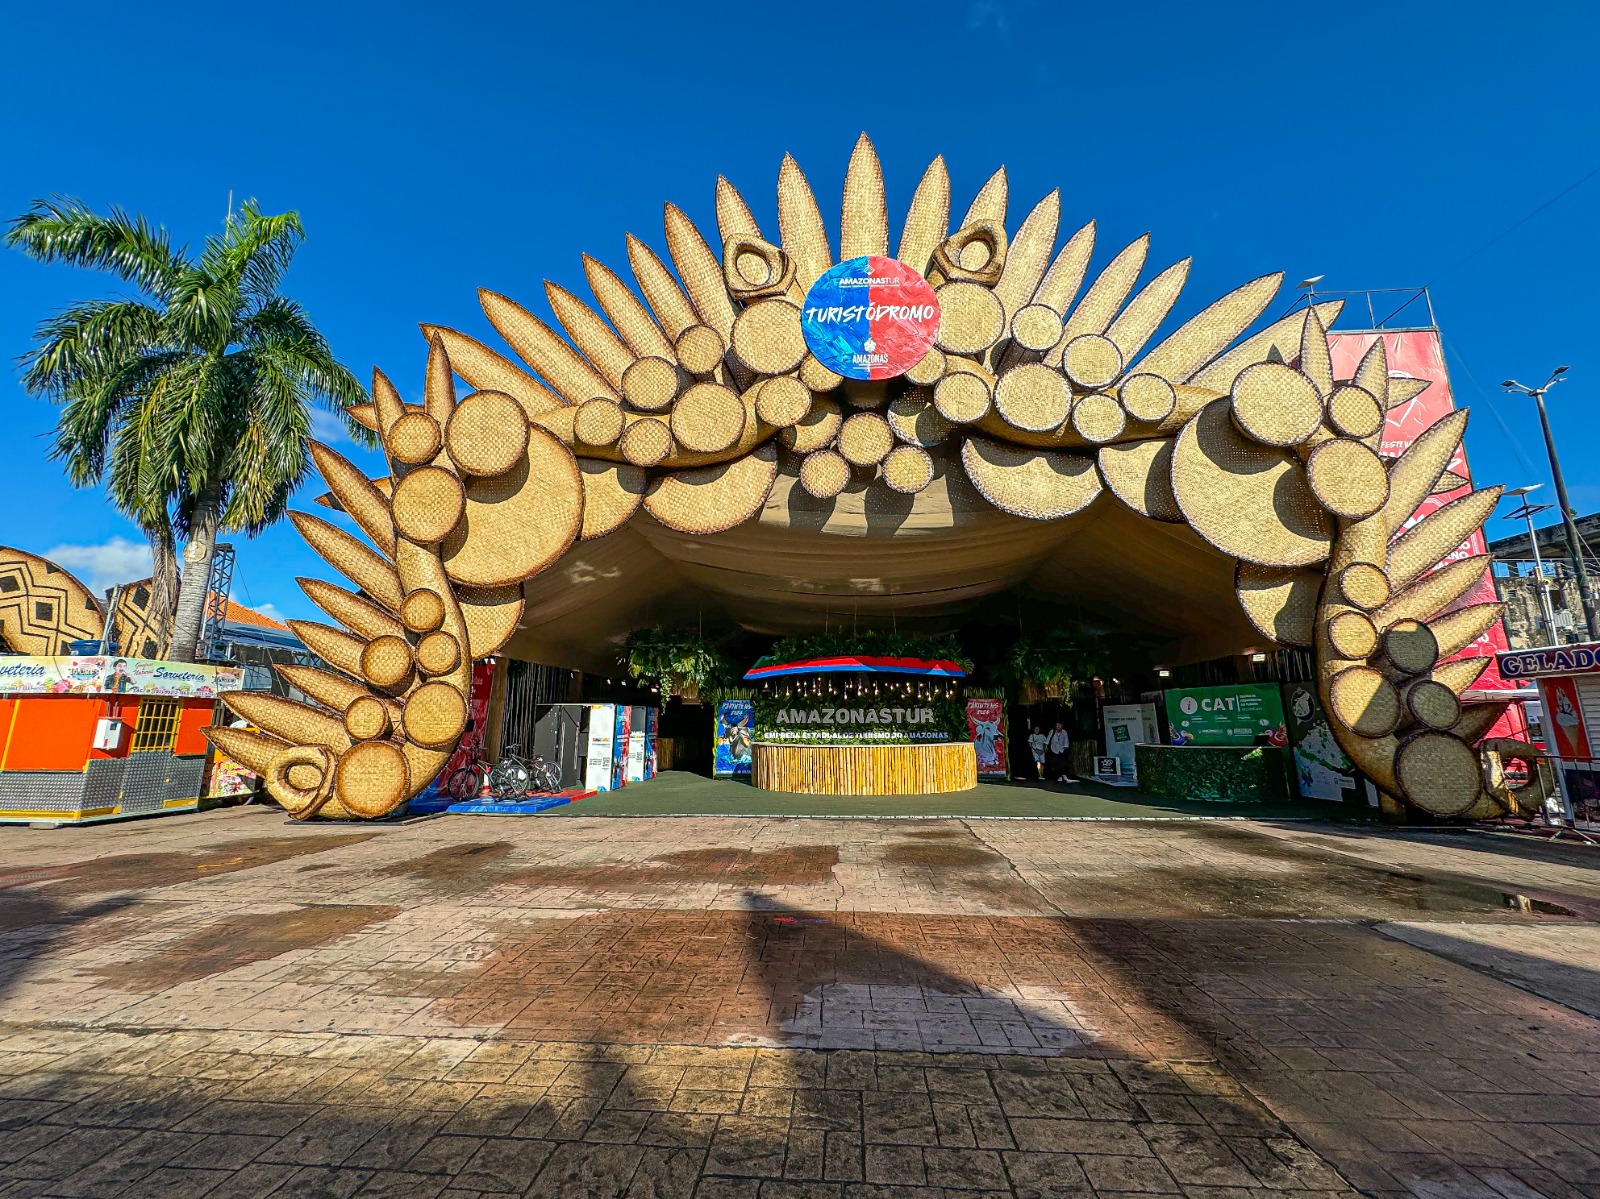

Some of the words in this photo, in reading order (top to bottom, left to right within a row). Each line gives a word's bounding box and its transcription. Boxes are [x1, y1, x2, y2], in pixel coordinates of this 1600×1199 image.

[839, 277, 900, 285] AMAZONASTUR
[805, 302, 935, 324] TURISTÓDROMO
[852, 354, 889, 364] AMAZONAS
[153, 666, 206, 682] Sorveteria
[1201, 697, 1235, 712] CAT
[776, 708, 935, 724] AMAZONASTUR
[904, 731, 949, 739] AMAZONAS
